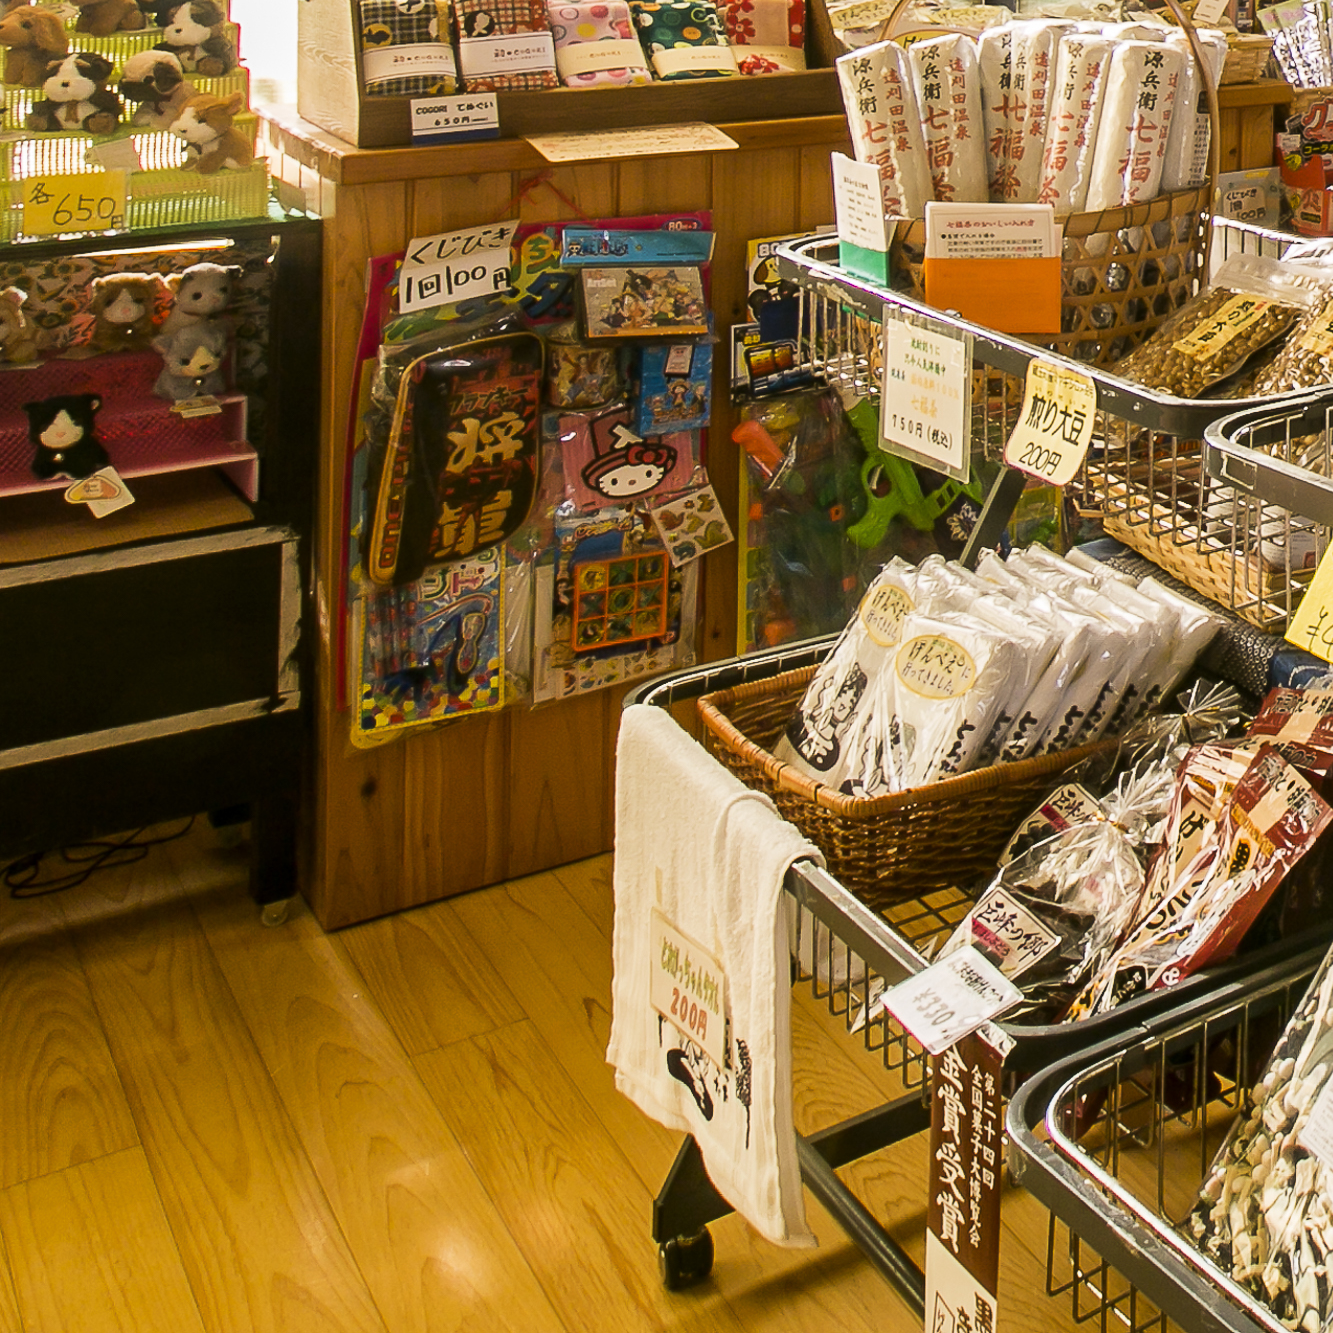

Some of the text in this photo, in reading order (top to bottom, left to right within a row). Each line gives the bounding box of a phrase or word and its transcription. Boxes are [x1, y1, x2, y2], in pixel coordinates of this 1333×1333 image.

[410, 227, 513, 265] くじびき
[1025, 391, 1088, 447] 煎り大豆
[1018, 441, 1063, 478] 200円
[670, 986, 708, 1042] 200円
[935, 1042, 968, 1255] 金賞受賞
